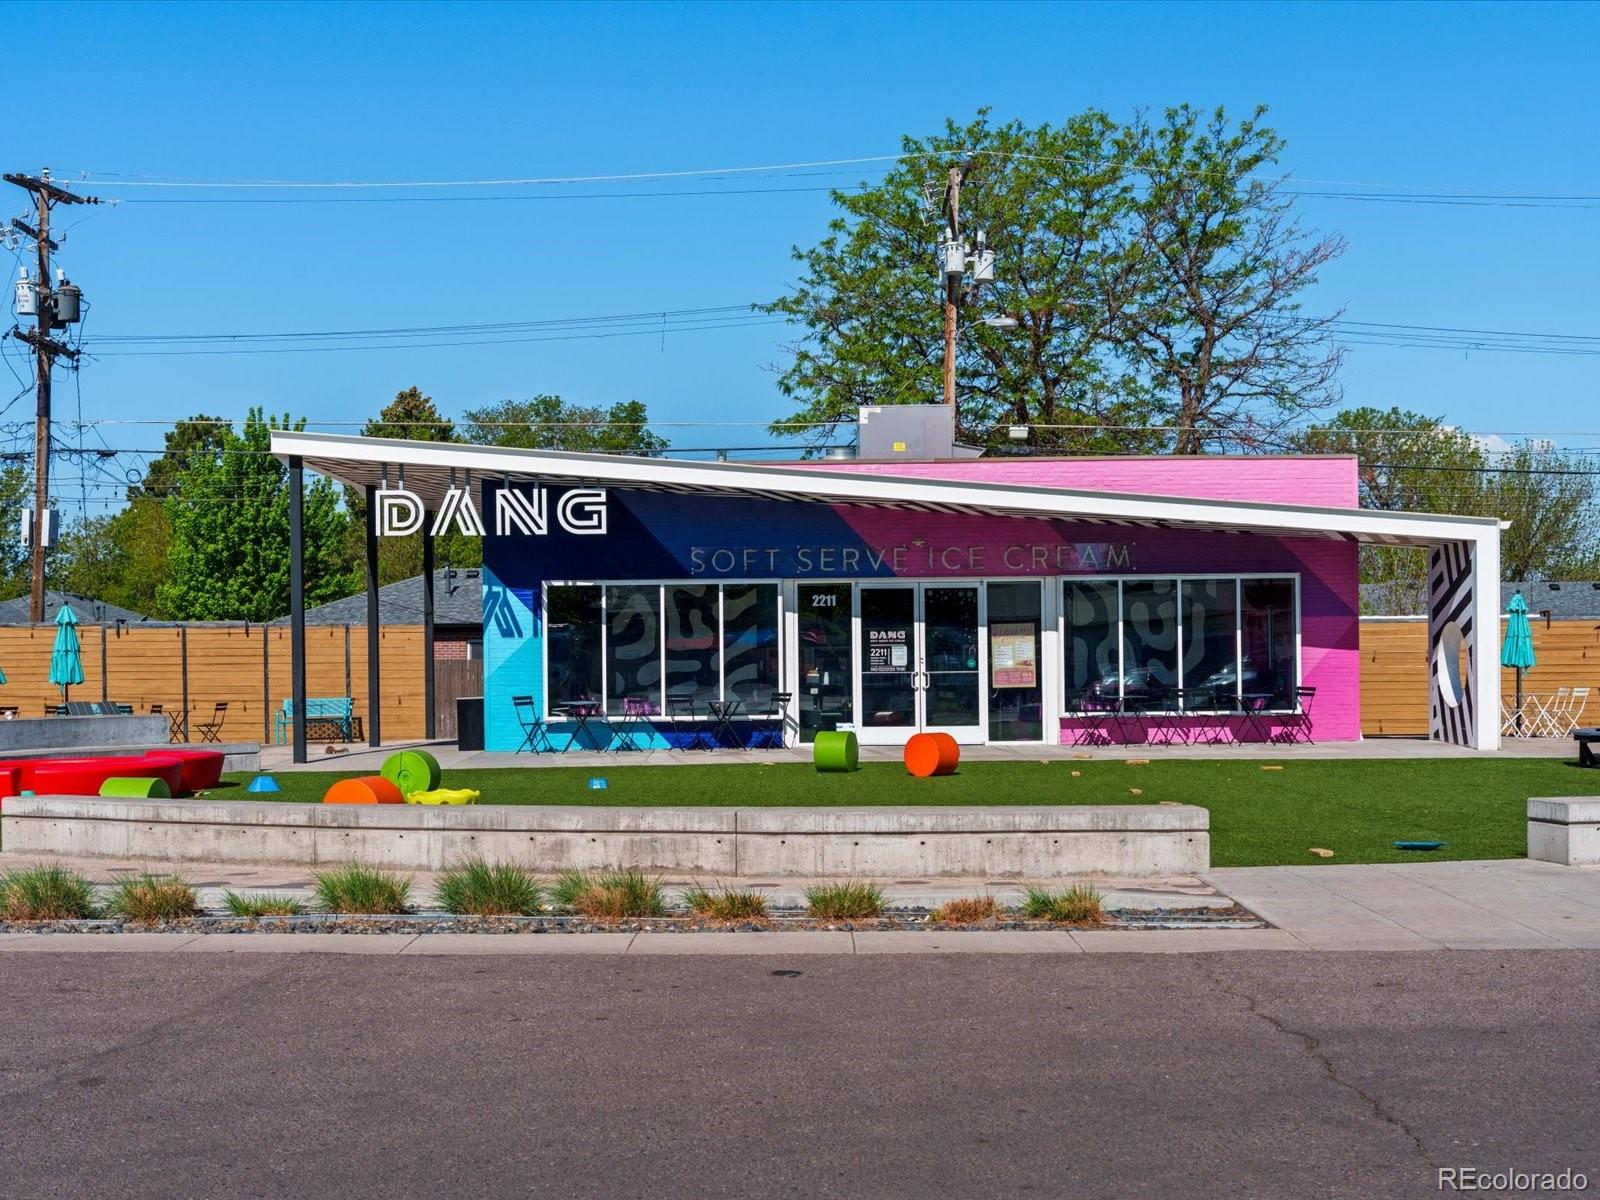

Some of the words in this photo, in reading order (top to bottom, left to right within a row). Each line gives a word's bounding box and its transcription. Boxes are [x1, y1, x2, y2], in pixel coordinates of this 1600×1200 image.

[375, 488, 607, 536] DANG
[691, 548, 780, 573] SOFT
[797, 547, 909, 572] SERVE
[928, 546, 985, 570] ICE
[1003, 544, 1131, 570] CREAM
[812, 594, 837, 607] 2211
[870, 630, 905, 639] DANG
[870, 648, 887, 656] 2211
